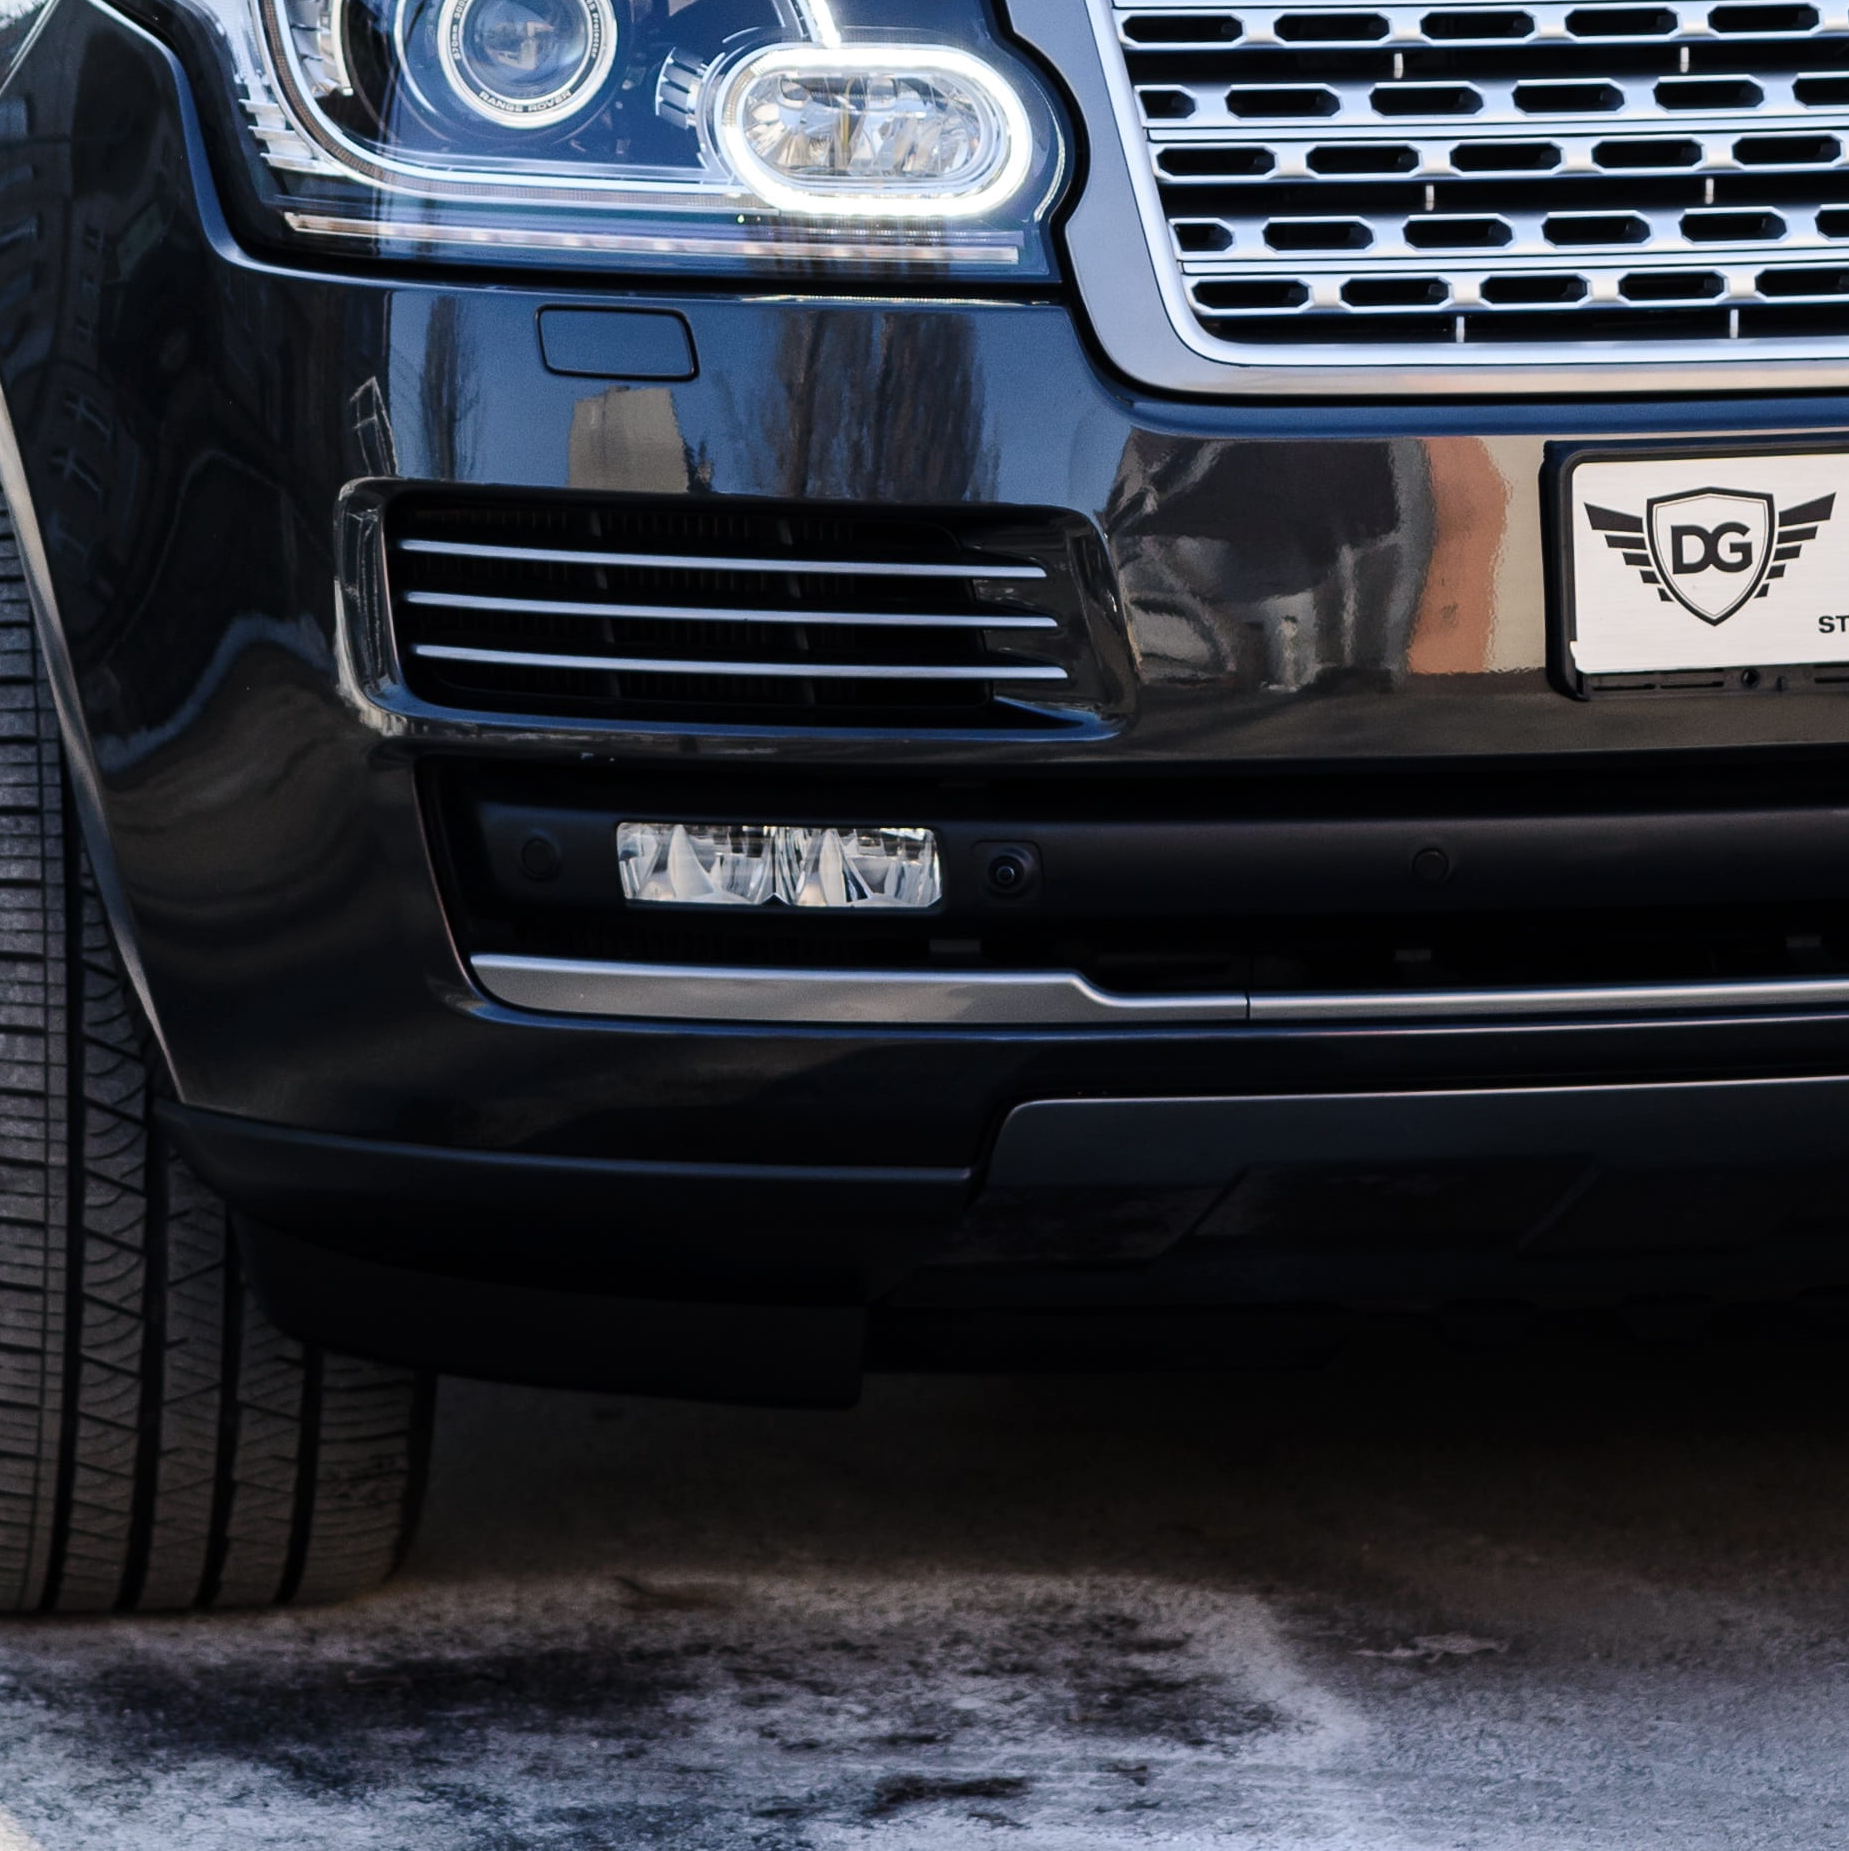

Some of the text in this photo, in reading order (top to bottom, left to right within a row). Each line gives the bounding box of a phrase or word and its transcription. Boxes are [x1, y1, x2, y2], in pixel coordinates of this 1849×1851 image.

[591, 12, 599, 58] Projector
[478, 89, 572, 113] RANGE ROVER
[1669, 520, 1754, 576] DG
